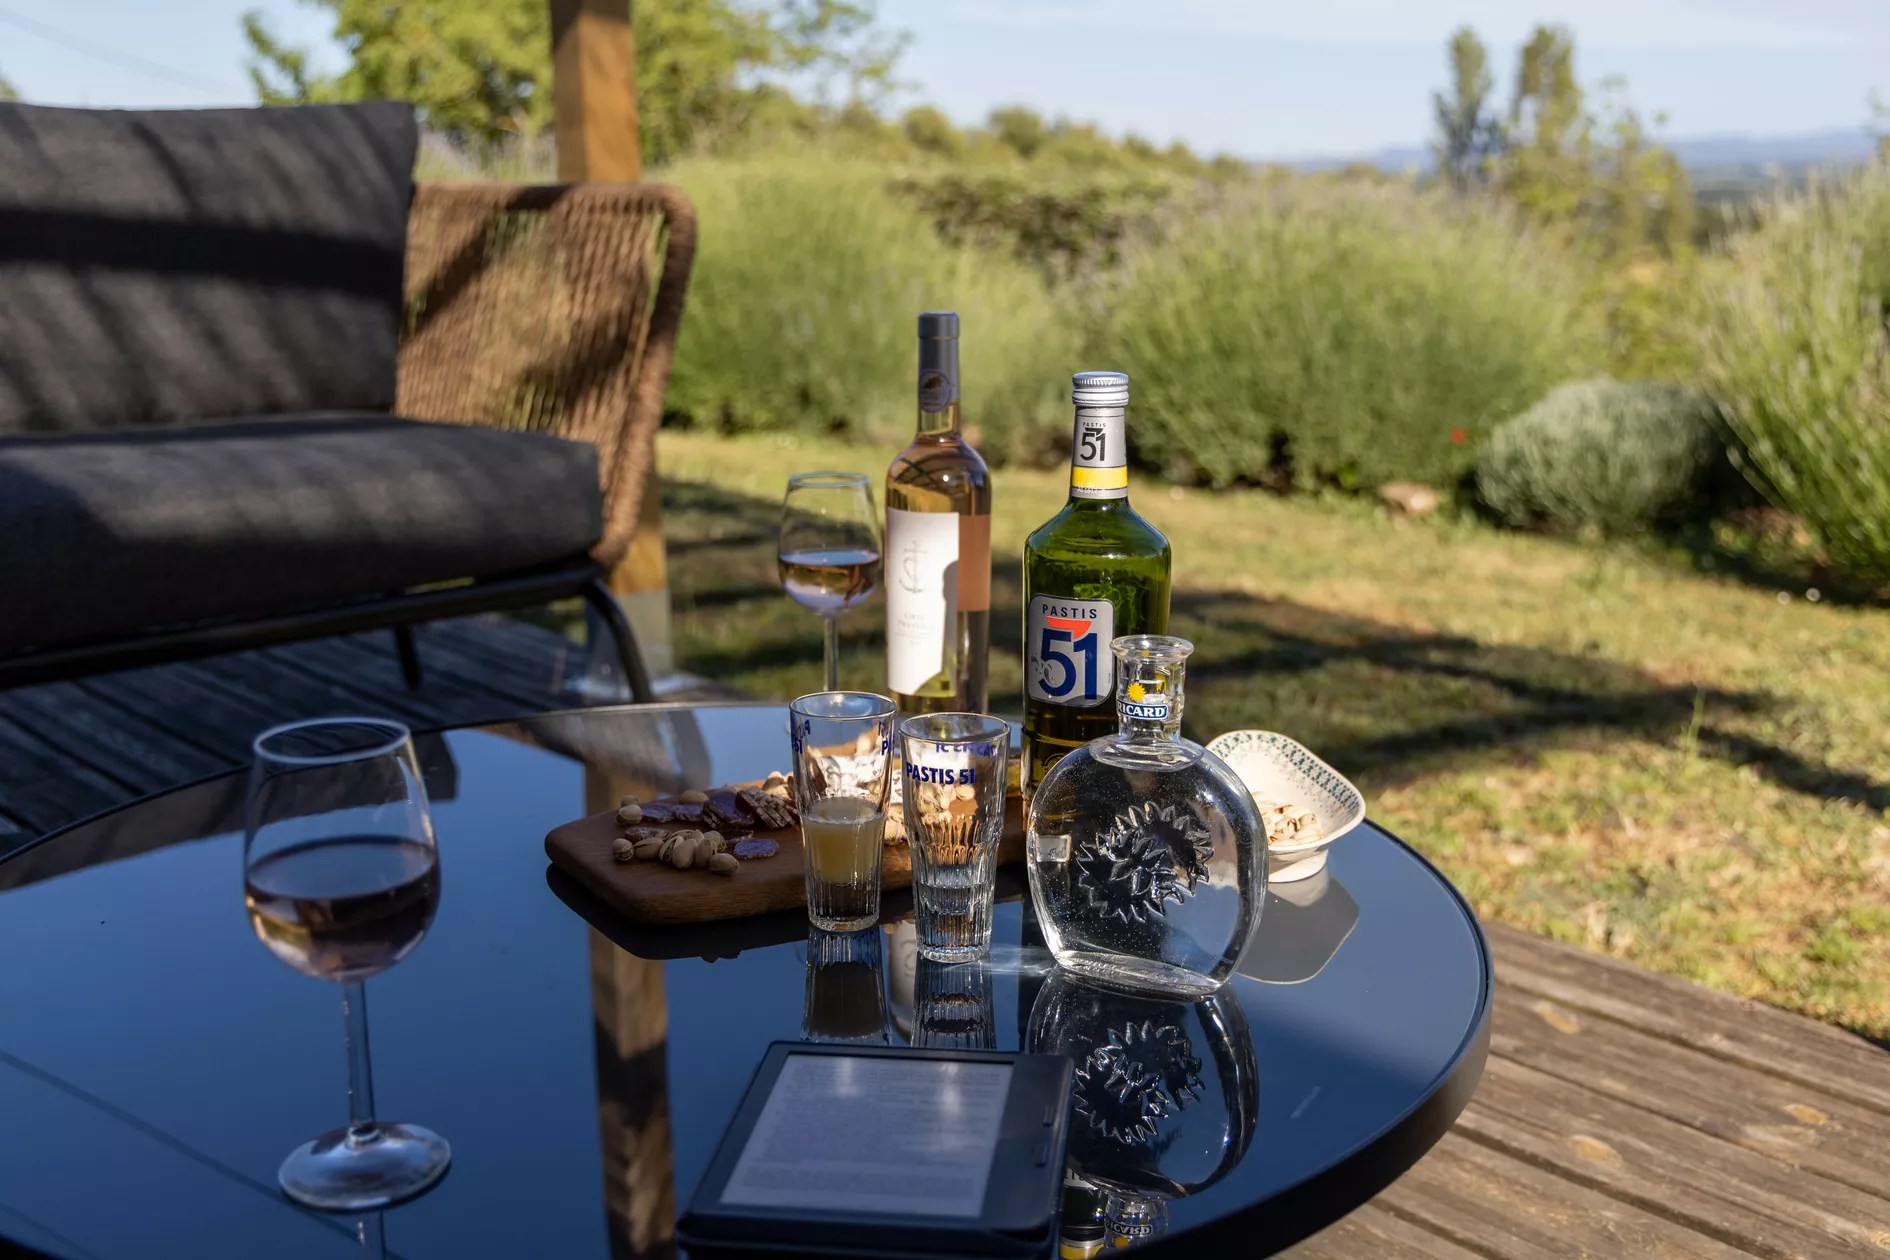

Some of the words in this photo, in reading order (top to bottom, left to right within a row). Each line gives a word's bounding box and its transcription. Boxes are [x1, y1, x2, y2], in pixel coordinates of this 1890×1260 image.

[1080, 432, 1106, 461] 51
[1042, 604, 1098, 619] PASTIS
[1038, 628, 1098, 700] 51
[1117, 701, 1166, 717] RICARD
[906, 762, 955, 784] PASTIS
[959, 768, 975, 785] 51
